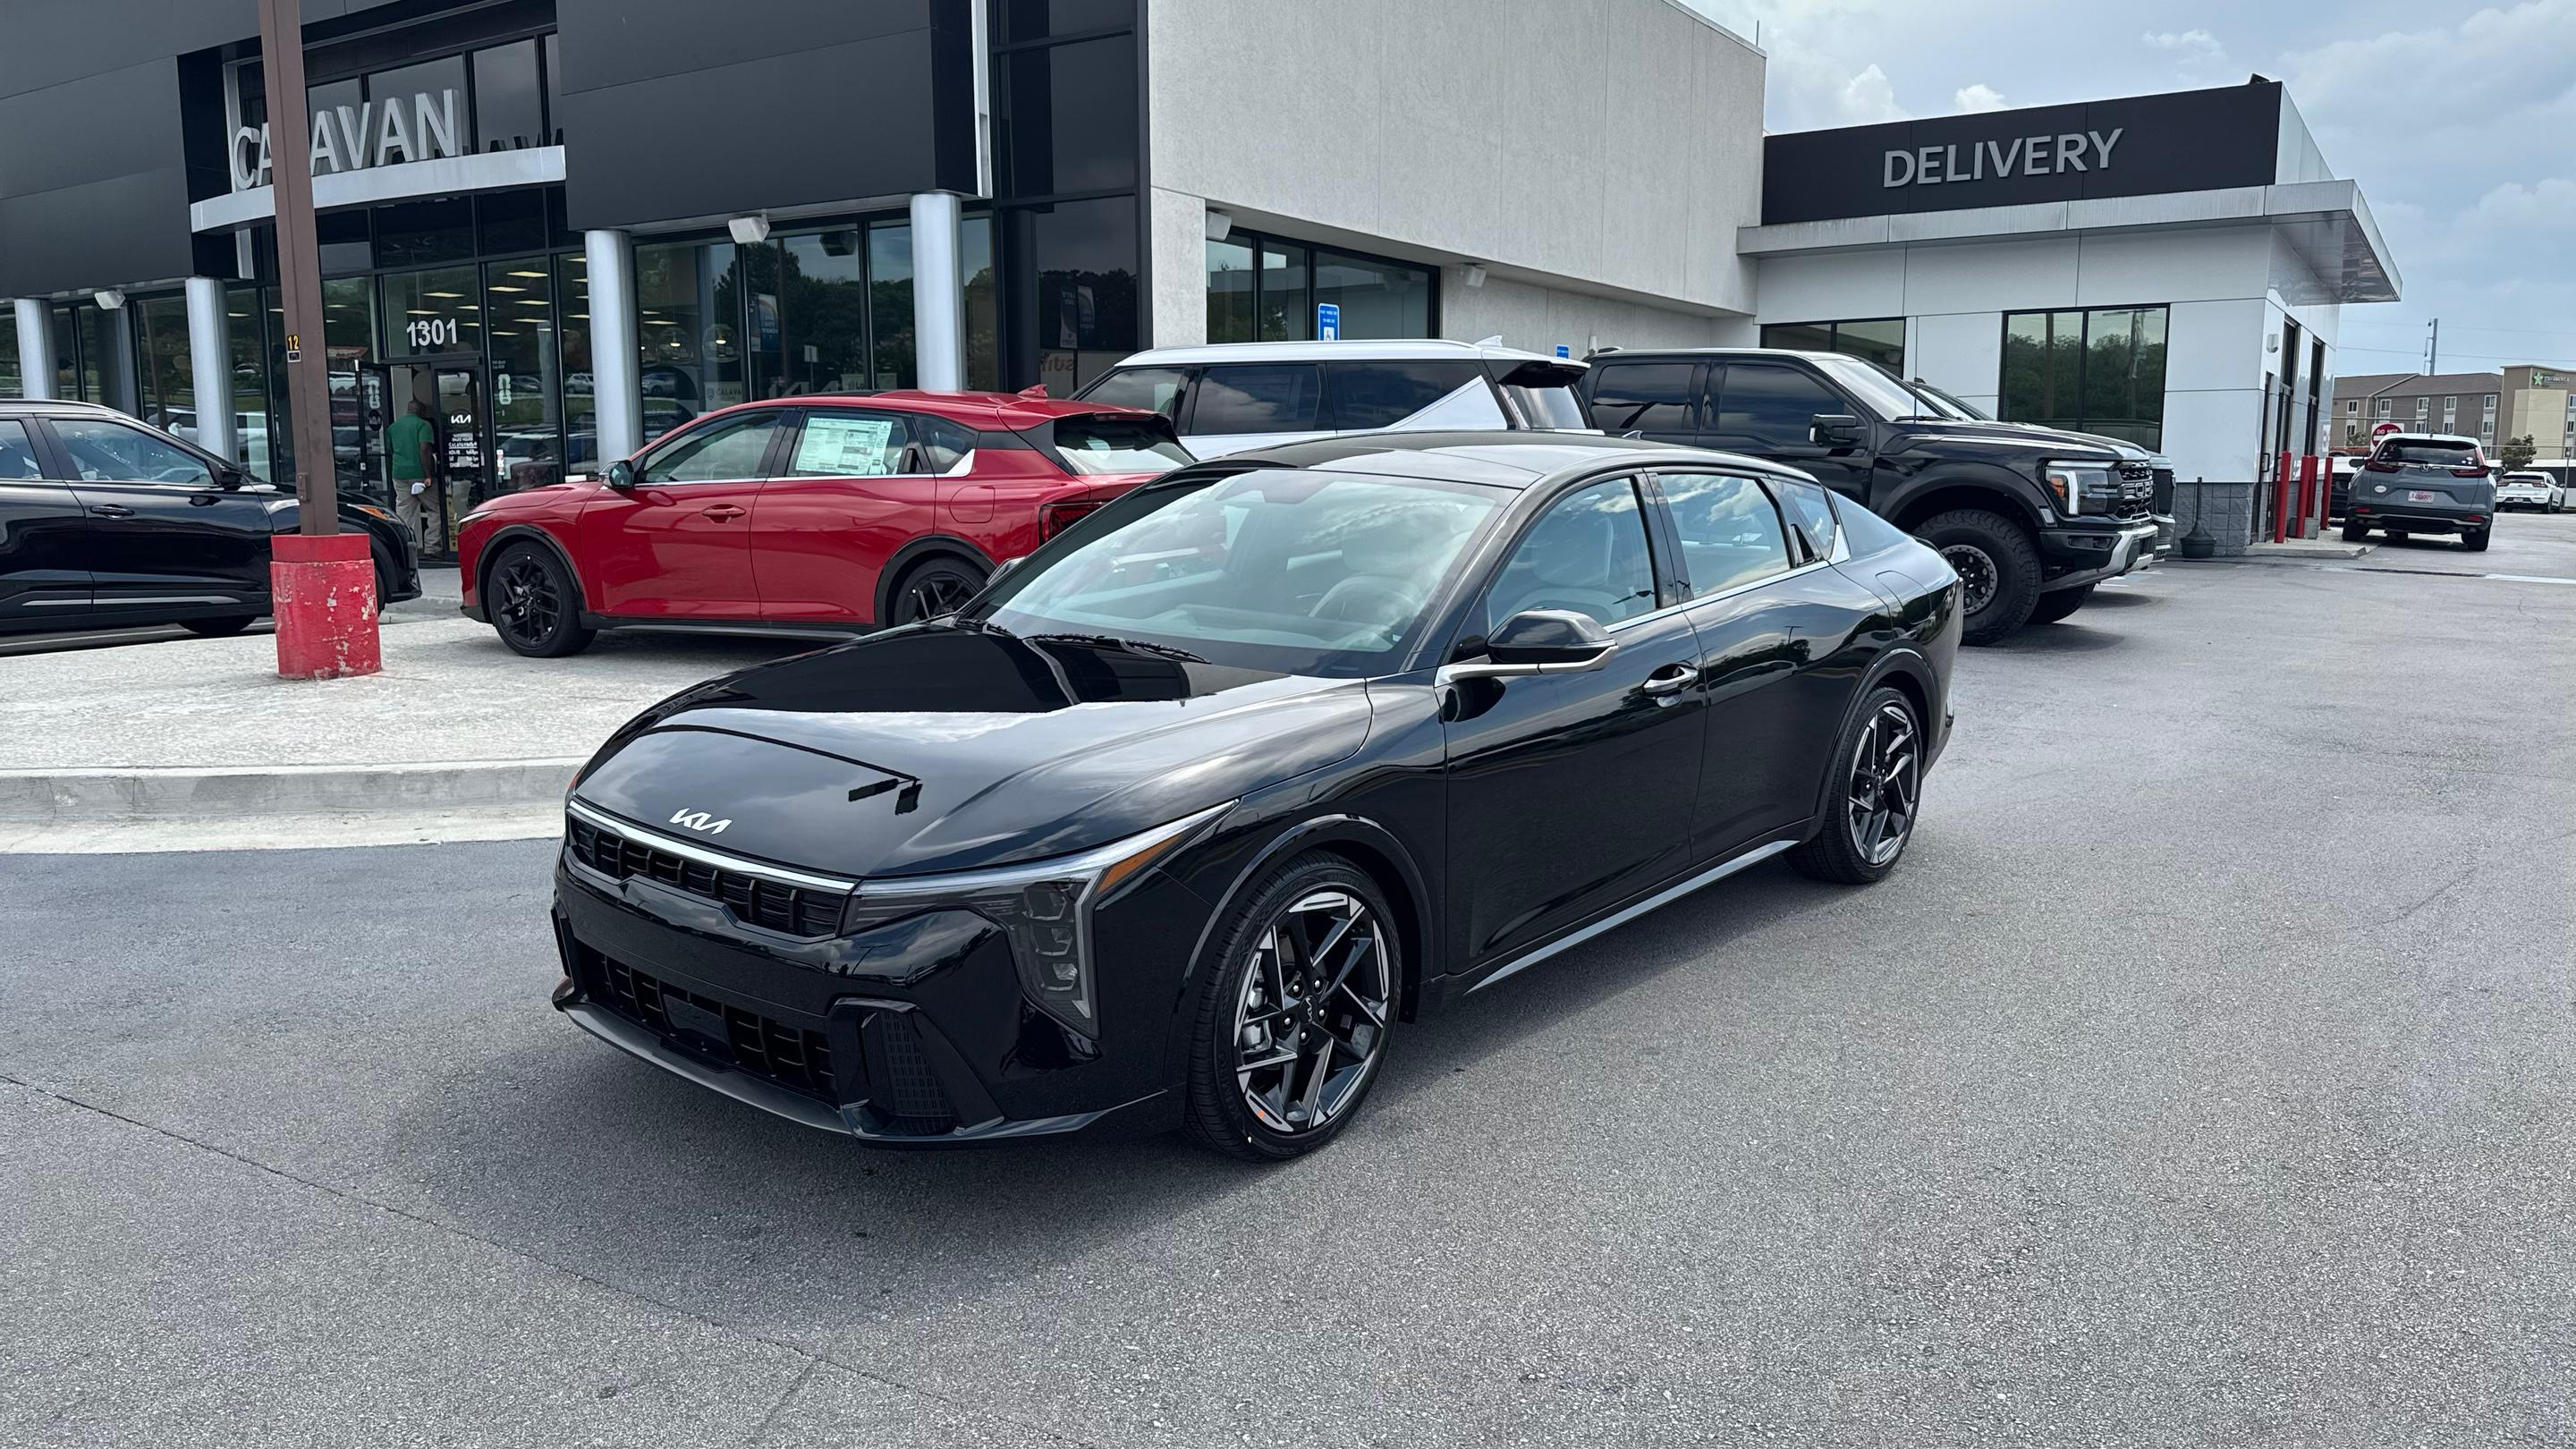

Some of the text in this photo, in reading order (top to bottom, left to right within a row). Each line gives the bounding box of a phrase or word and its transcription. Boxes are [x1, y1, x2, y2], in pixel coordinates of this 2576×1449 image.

[233, 89, 460, 190] CAAVAN
[1883, 127, 2124, 189] DELIVERY
[287, 334, 300, 351] 12
[406, 318, 458, 347] 1301
[450, 414, 472, 425] KIA
[668, 807, 733, 835] KIA
